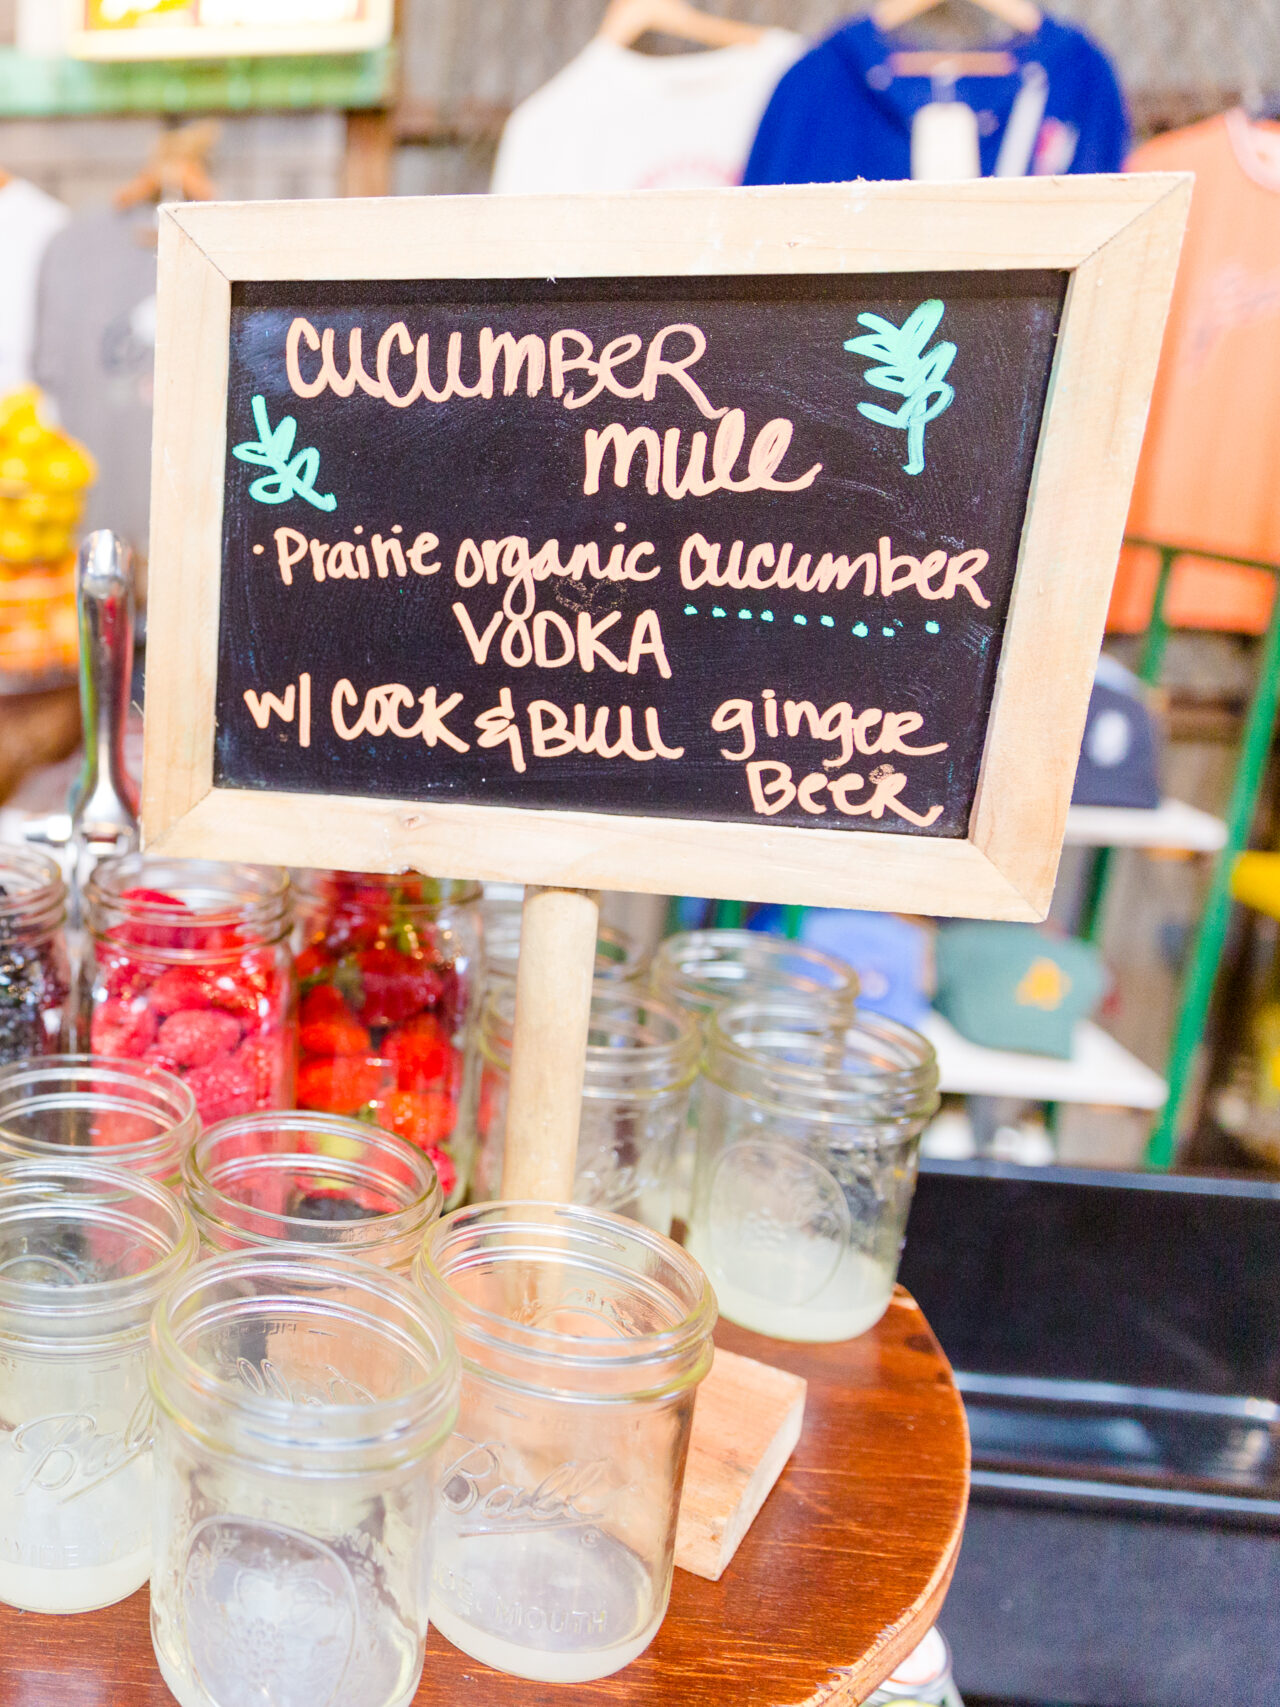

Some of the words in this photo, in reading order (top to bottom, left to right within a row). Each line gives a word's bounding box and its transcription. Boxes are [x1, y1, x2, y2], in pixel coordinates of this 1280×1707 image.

[273, 524, 442, 586] Prairie
[455, 522, 661, 622] organic
[451, 601, 672, 679] VODKA
[243, 672, 311, 748] w/
[438, 1432, 610, 1537] Ball
